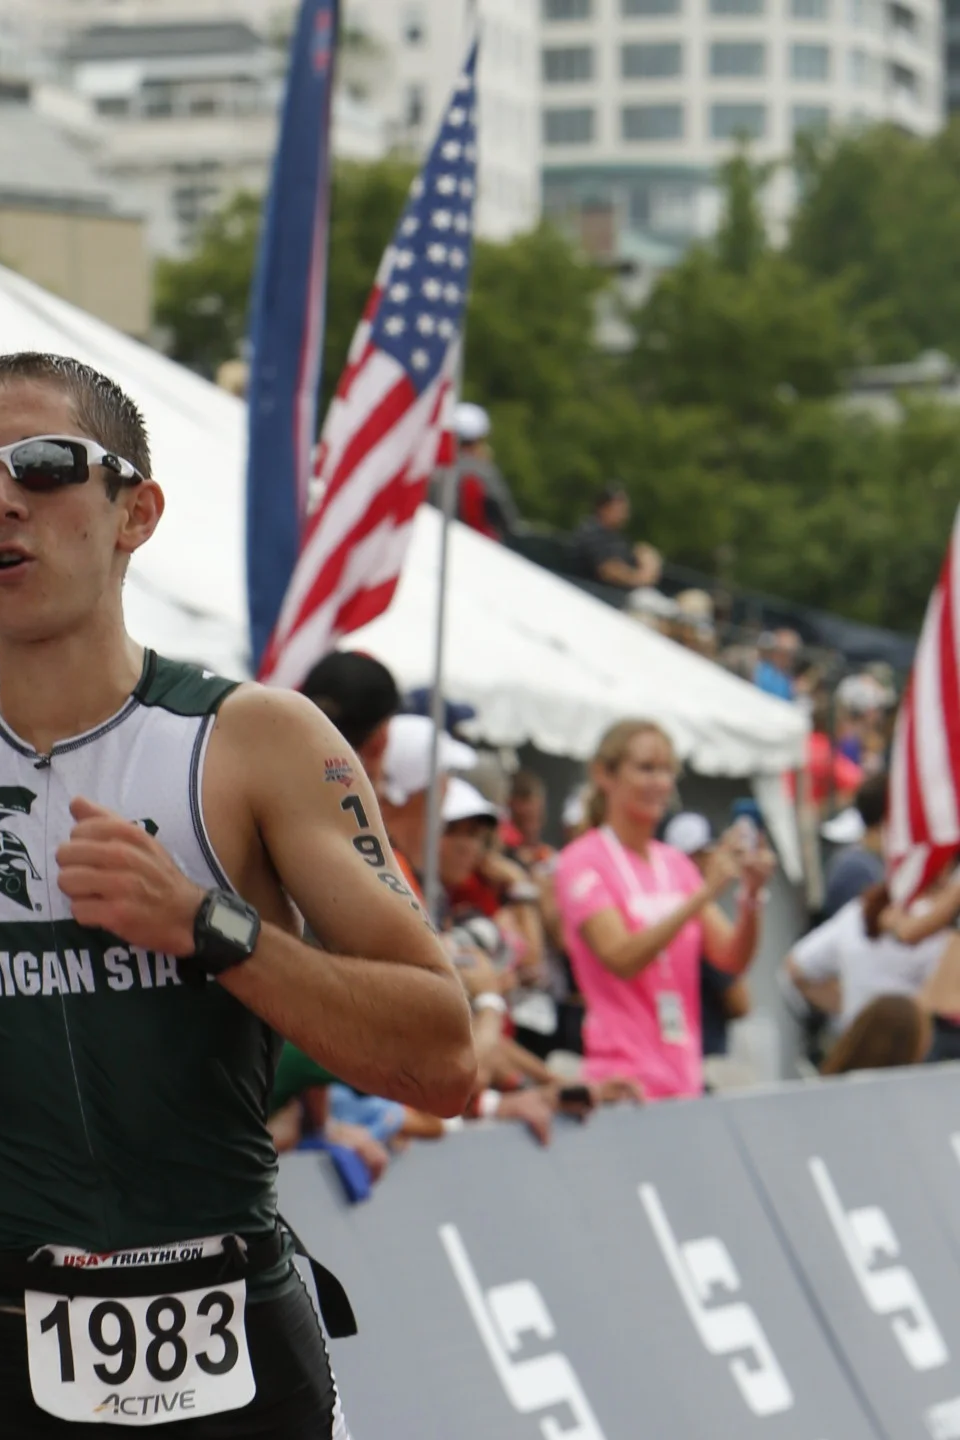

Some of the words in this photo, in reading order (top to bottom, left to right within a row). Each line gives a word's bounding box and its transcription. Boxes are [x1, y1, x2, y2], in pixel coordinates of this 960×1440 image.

[341, 795, 432, 929] 198
[63, 1253, 99, 1267] USA
[111, 1247, 203, 1266] TRIATHLON
[40, 1290, 239, 1385] 1983
[93, 1390, 195, 1416] ACTIVE
